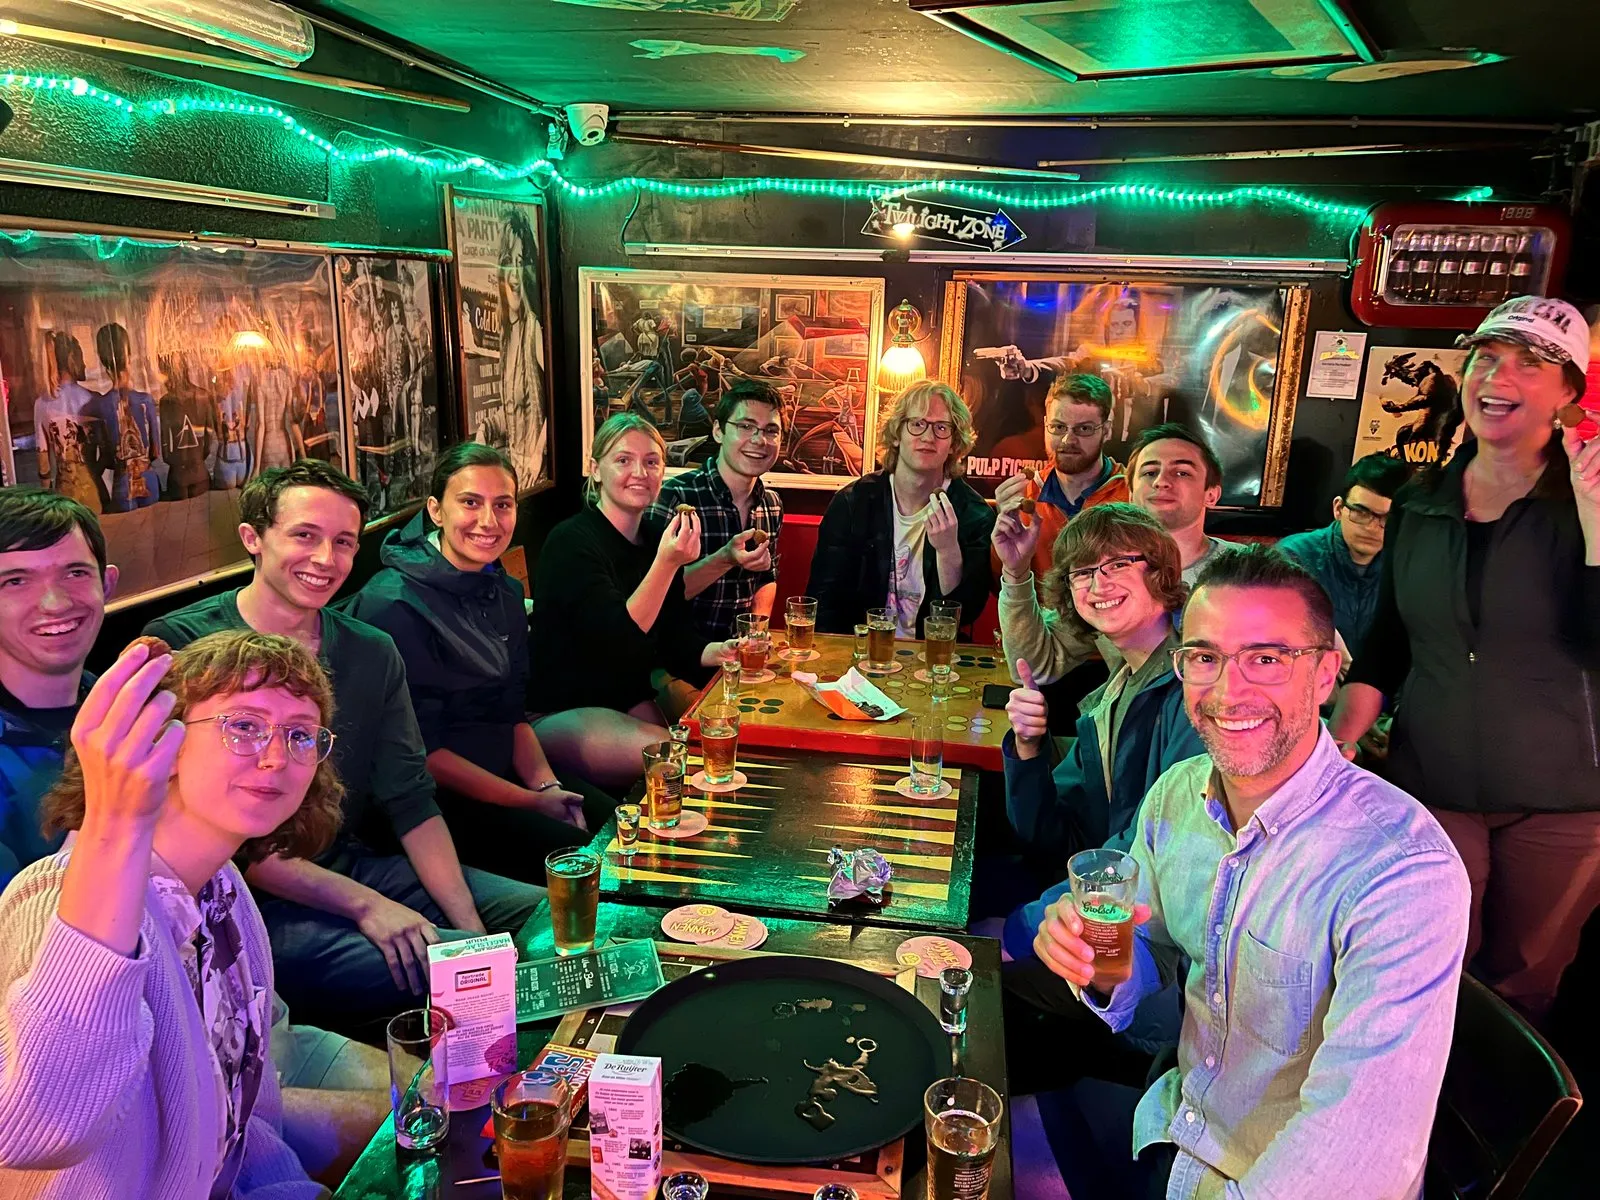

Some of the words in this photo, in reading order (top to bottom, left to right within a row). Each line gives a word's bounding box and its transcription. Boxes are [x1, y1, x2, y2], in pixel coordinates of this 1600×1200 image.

[881, 201, 959, 234] TWILIGHT
[960, 215, 1007, 240] ZONE
[967, 456, 1001, 476] PULP
[1082, 900, 1116, 914] Grolsch
[669, 920, 720, 937] MANNEN
[459, 976, 488, 986] ORIGINAL
[461, 972, 485, 981] fairtrade
[604, 1063, 618, 1071] De
[617, 1063, 647, 1073] Ruijter
